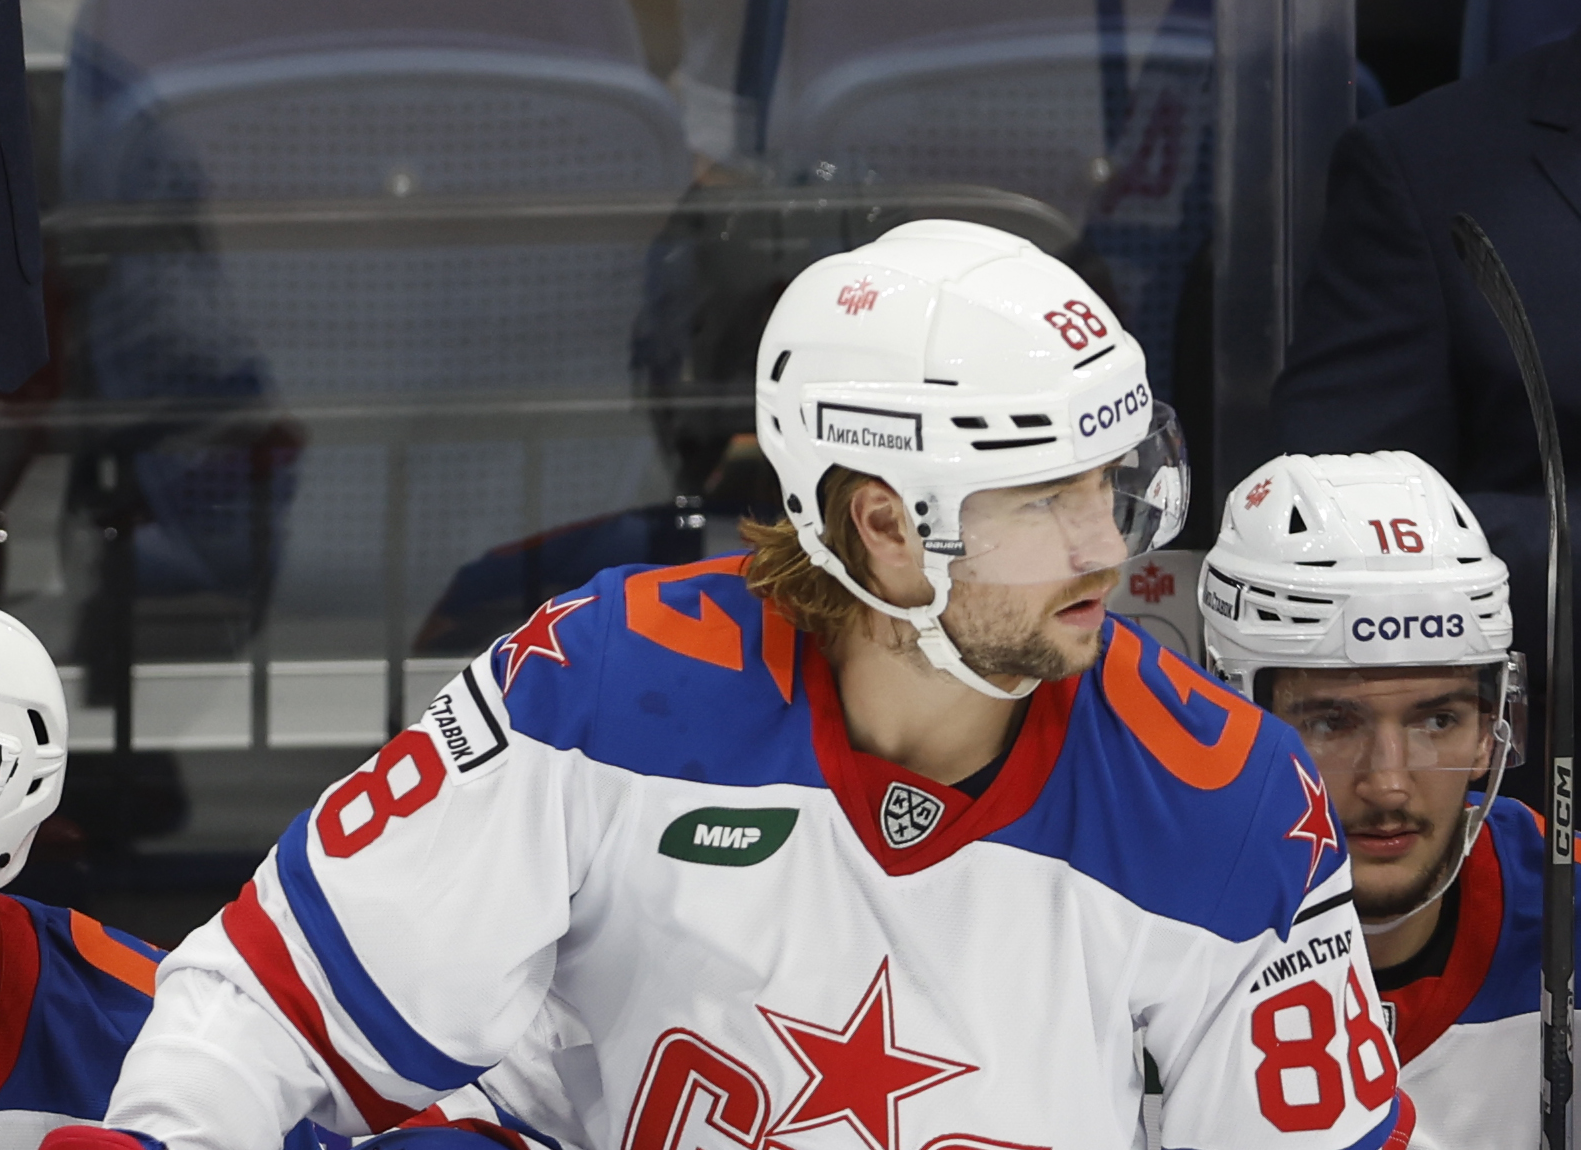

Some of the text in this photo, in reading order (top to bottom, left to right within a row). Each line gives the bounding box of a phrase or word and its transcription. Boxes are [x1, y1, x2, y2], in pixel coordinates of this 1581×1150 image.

[1043, 299, 1108, 351] 88
[1367, 518, 1425, 554] 16
[693, 823, 761, 849] МИР
[1556, 766, 1572, 858] CCM
[1251, 962, 1399, 1133] 88
